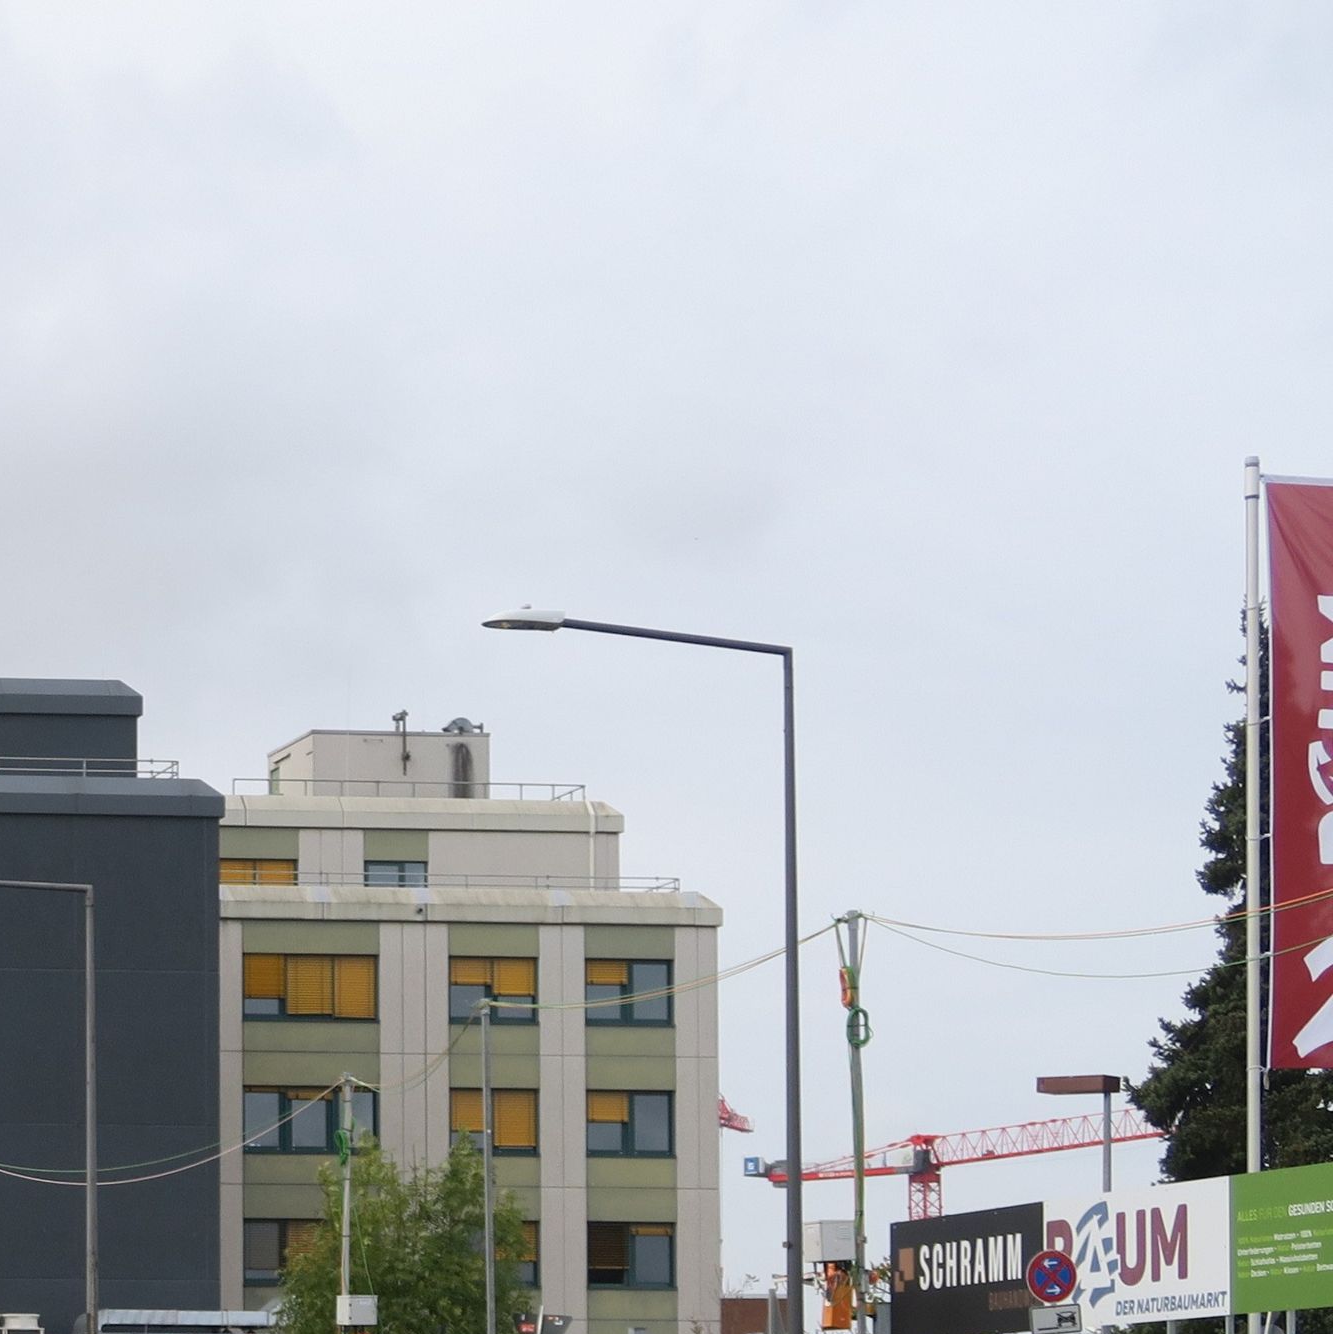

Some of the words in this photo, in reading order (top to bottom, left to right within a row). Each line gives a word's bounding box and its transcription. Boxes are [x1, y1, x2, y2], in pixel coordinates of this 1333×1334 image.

[1288, 1200, 1325, 1216] GESUNDEN
[919, 1232, 1022, 1291] SCHRAMM
[1116, 1299, 1135, 1316] DER
[1137, 1291, 1227, 1315] NATURBAUMARKT
